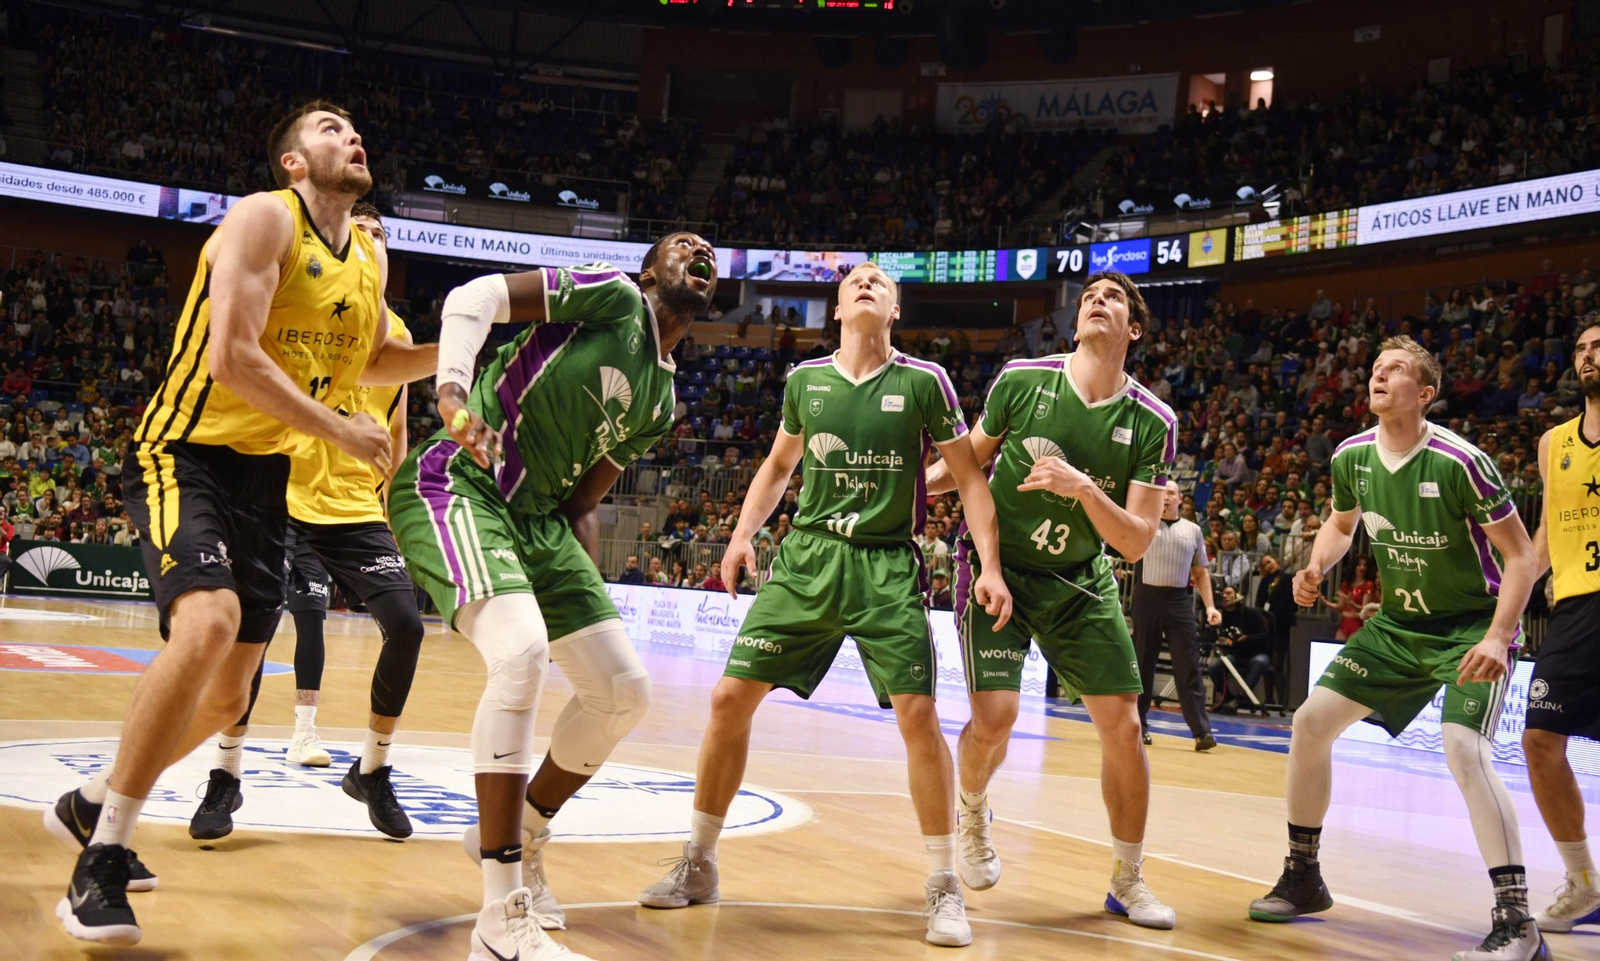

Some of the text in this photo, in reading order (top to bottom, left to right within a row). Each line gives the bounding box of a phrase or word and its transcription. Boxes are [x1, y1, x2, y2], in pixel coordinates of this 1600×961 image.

[0, 174, 147, 206] idades desde 485.000 €
[1371, 208, 1432, 232] ÁTICOS
[1438, 199, 1490, 223] LLAVE
[1496, 193, 1520, 214] EN
[1526, 184, 1584, 209] MANO
[397, 228, 448, 247] LLAVE
[454, 235, 475, 250] EN
[481, 238, 531, 256] MANO
[540, 243, 579, 259] Últimas
[582, 250, 627, 263] unidades
[1156, 239, 1182, 265] 54
[1057, 249, 1083, 273] 70
[277, 328, 359, 349] IBEROST
[806, 384, 832, 392] SPALDING
[845, 449, 904, 468] Unicaja
[835, 473, 878, 502] Málaga
[1030, 518, 1071, 556] 43
[1393, 530, 1449, 548] Unicaja
[1563, 524, 1591, 533] HOTELS
[1387, 547, 1428, 576] Málaga
[75, 569, 150, 592] Unicaja
[1394, 587, 1431, 615] 21
[736, 635, 783, 654] worten
[979, 648, 1024, 662] worten
[983, 670, 1009, 678] SPALDING
